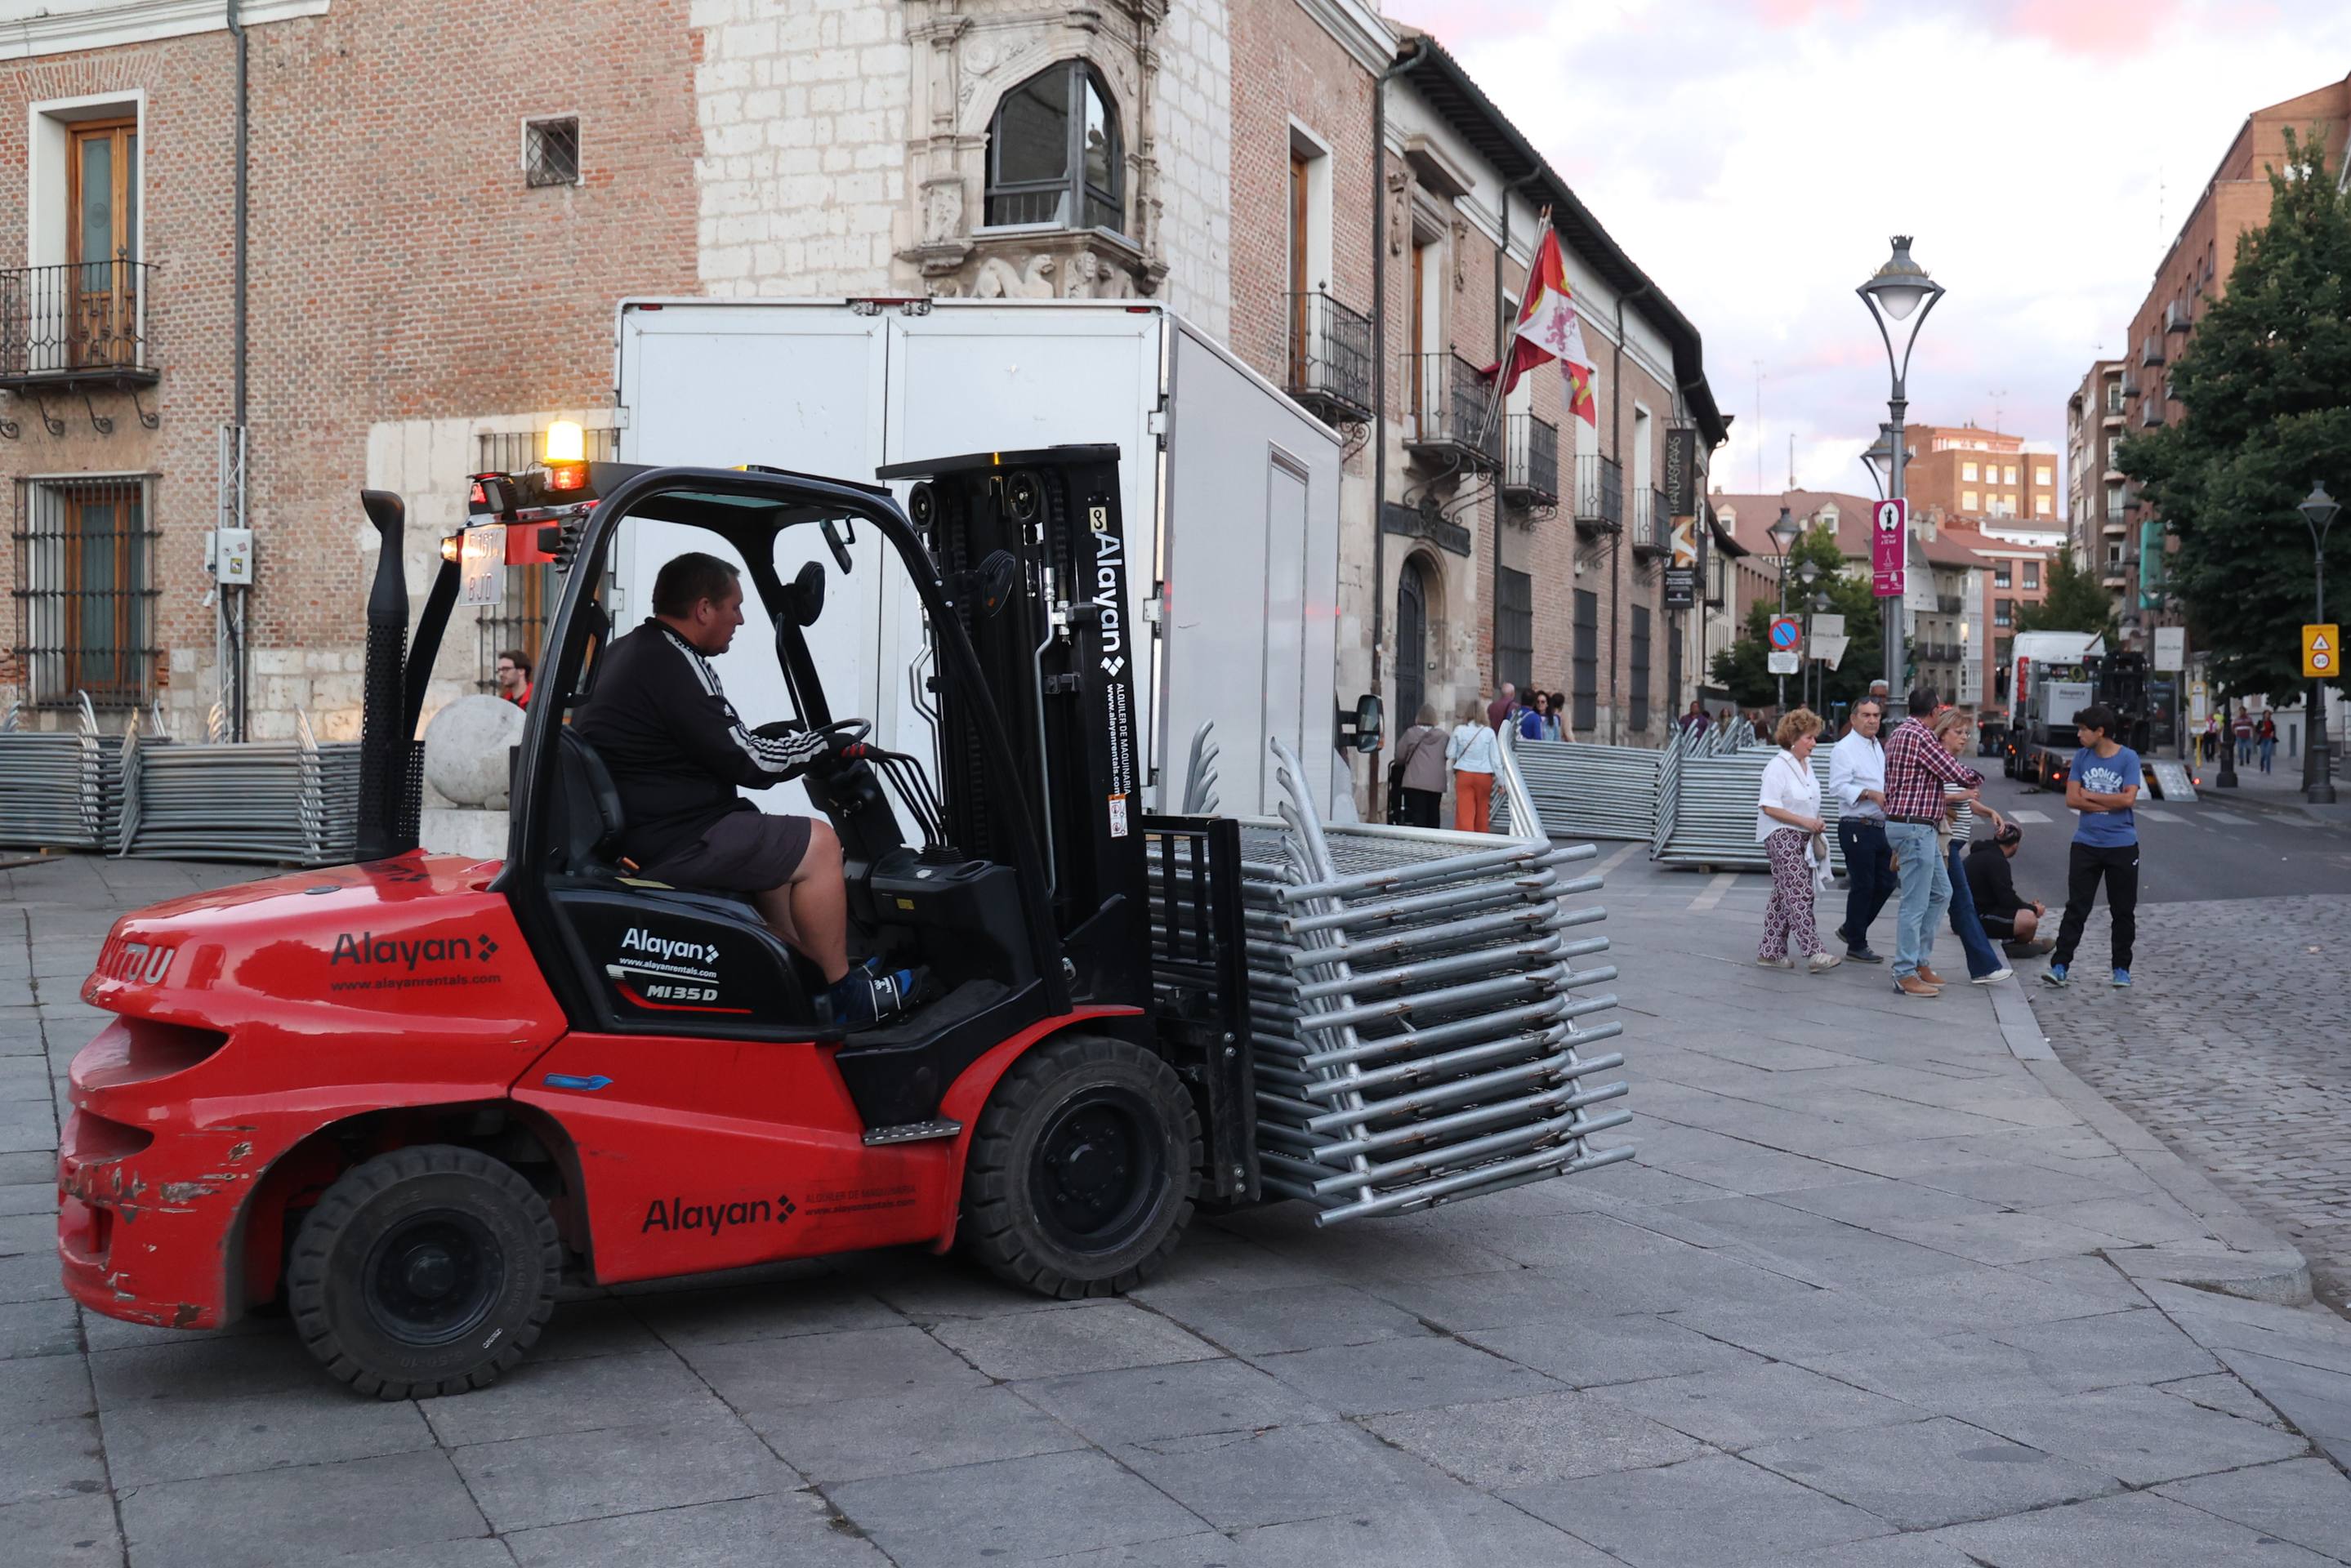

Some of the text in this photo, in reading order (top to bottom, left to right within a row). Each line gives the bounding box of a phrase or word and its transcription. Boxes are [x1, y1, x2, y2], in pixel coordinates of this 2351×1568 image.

[1092, 532, 1122, 653] Alayan
[1107, 683, 1121, 795] www.alayanrentals.com
[1116, 683, 1131, 795] ALQUILER DE MAQUINARIA
[331, 931, 471, 971] Alayan
[622, 928, 703, 960] Alayan
[331, 972, 501, 992] www.alayanrentals.com
[618, 958, 717, 979] www.alayanrentals.com
[641, 1196, 771, 1236] Alayan
